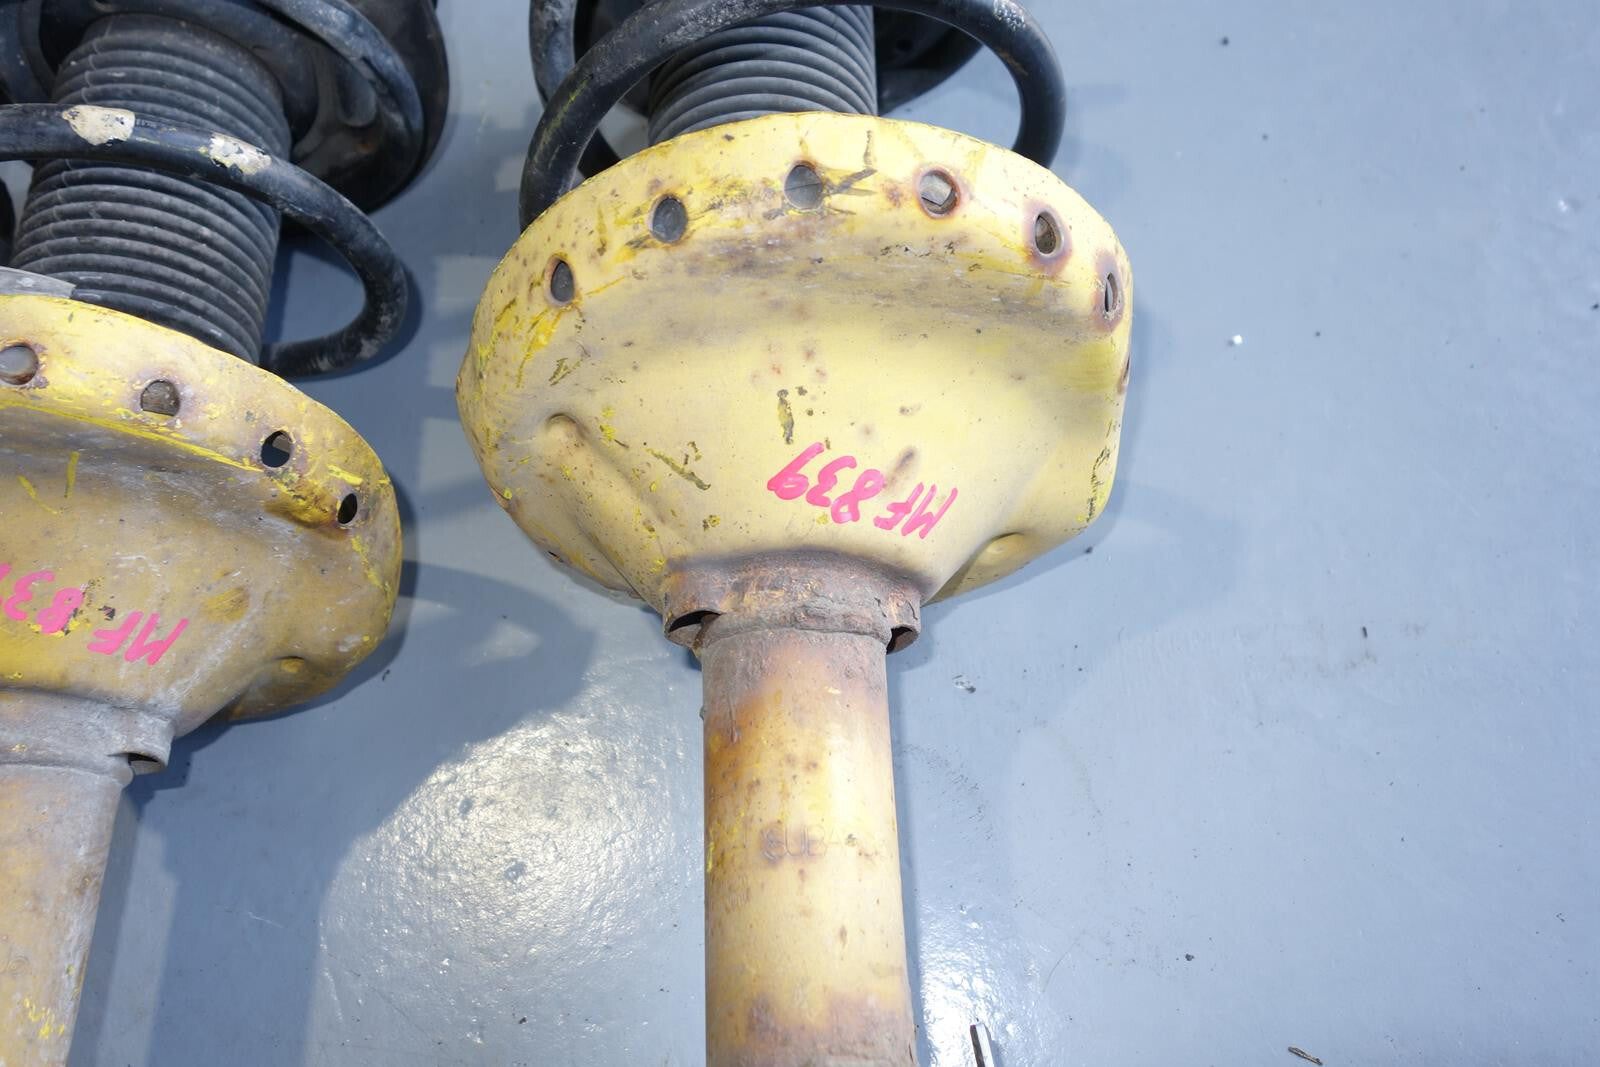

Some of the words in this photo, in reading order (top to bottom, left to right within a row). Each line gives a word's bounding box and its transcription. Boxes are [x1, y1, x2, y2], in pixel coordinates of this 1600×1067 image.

[766, 442, 886, 524] 839
[873, 482, 958, 540] MF
[87, 611, 189, 667] MF
